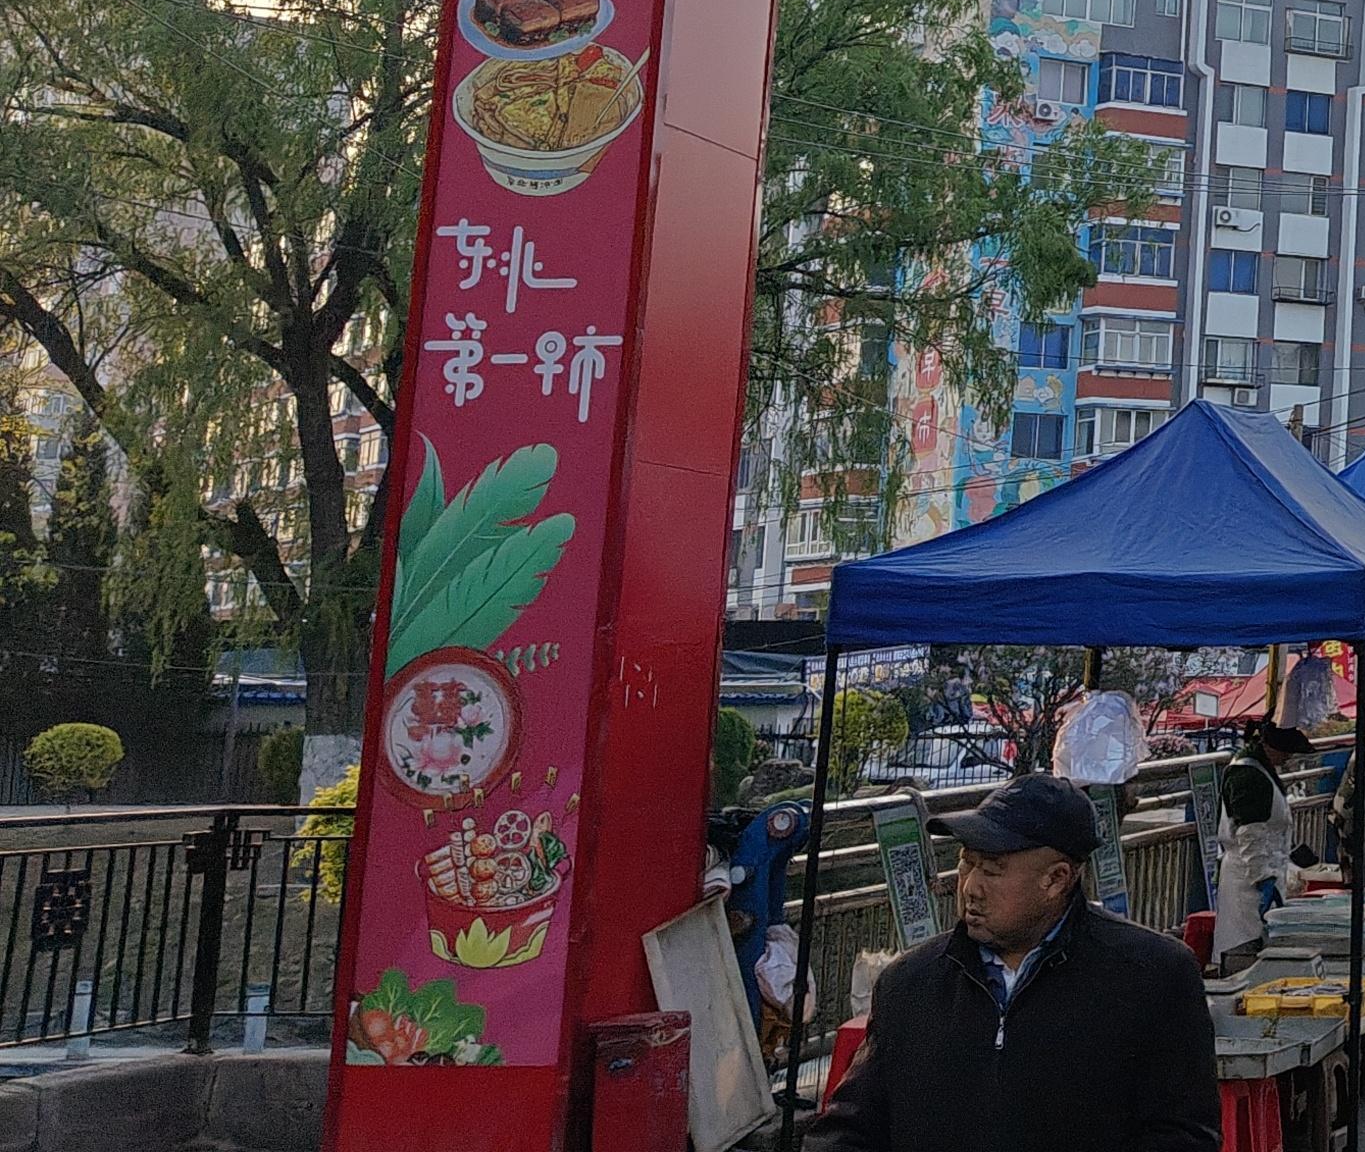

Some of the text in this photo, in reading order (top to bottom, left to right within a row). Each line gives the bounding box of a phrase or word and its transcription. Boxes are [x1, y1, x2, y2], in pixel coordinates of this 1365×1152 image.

[435, 217, 578, 314] 东北
[423, 311, 624, 424] 第一早市
